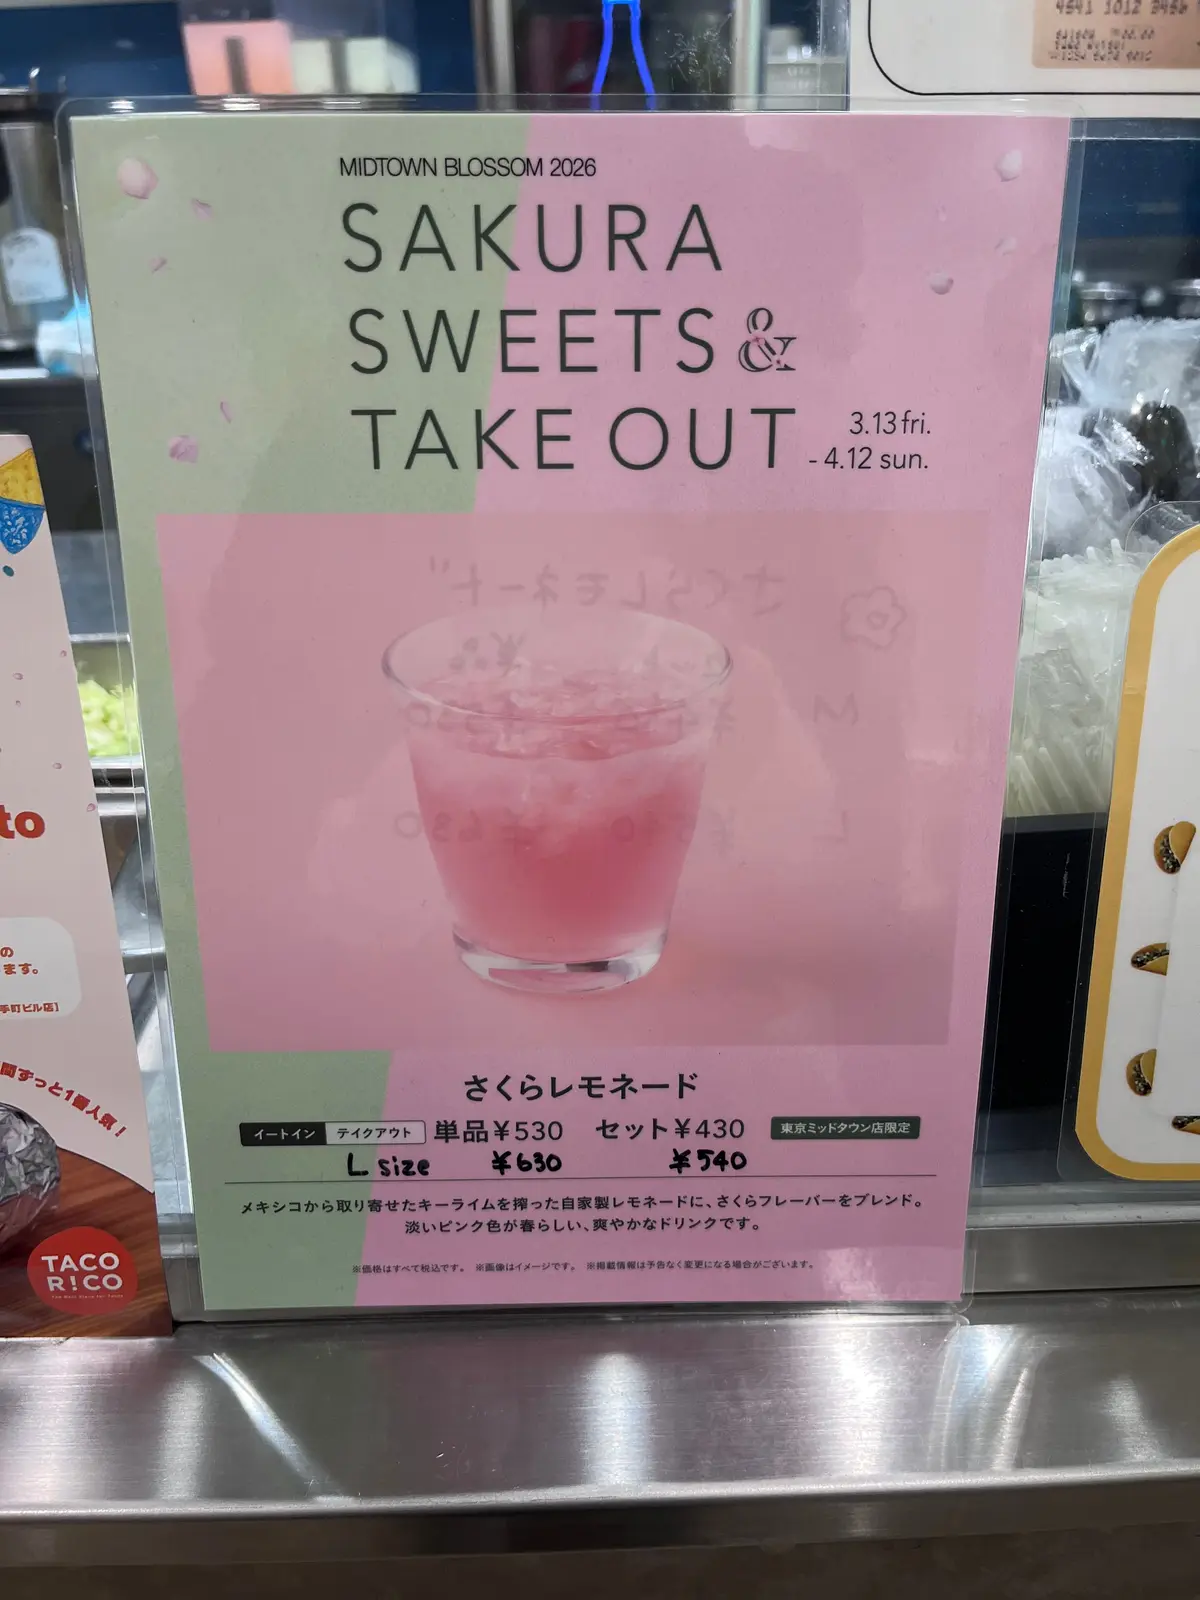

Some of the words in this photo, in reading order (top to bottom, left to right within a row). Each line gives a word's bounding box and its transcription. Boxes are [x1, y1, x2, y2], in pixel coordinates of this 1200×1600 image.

[339, 157, 438, 178] MIDTOWN
[444, 157, 543, 178] BLOSSOM
[549, 157, 597, 178] 2026
[341, 202, 723, 273] SAKURA
[349, 307, 715, 375] SWEETS
[738, 307, 798, 373] &
[350, 408, 576, 471] TAKE
[608, 406, 796, 471] OUT
[879, 453, 929, 470] sun.
[0, 947, 14, 958] の
[464, 1073, 699, 1102] さくらレモネード
[254, 1128, 316, 1141] イートイン
[337, 1127, 411, 1139] テイクアウト
[434, 1120, 564, 1143] 単品¥530
[595, 1117, 745, 1140] セット¥430
[780, 1122, 911, 1134] 東京ミッドタウン店限定
[347, 1152, 369, 1177] L
[378, 1155, 430, 1177] size
[491, 1150, 562, 1176] ¥630
[669, 1148, 748, 1174] ¥540
[240, 1193, 922, 1214] メキシコから取り寄せたキーライムを搾った自家製レモネードに、さくらフレーバーをブレンド。
[404, 1216, 760, 1234] 淡いピンク色が春らしい、爽やかなドリンクです。
[41, 1252, 120, 1273] TACO
[46, 1274, 123, 1292] R!CO
